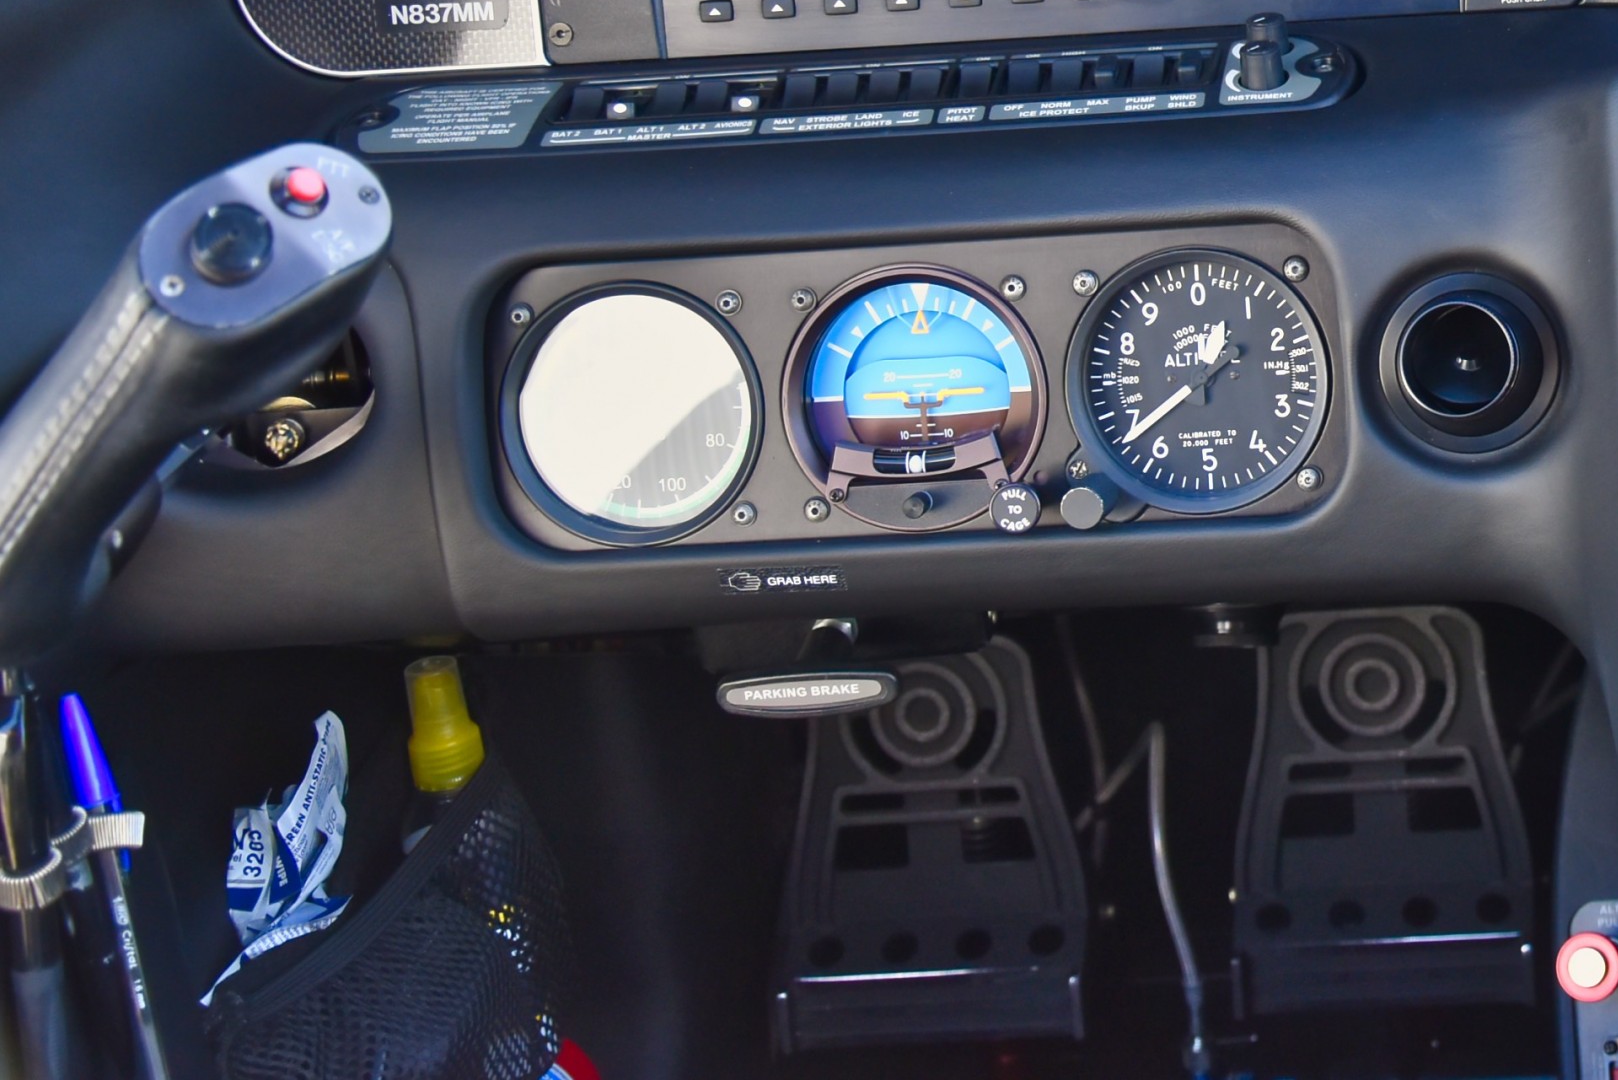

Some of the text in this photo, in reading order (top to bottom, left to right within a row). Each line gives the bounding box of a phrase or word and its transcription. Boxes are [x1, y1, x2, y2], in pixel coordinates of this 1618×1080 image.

[390, 1, 494, 25] N837MM
[1227, 91, 1294, 102] INSTRUMENT
[714, 120, 753, 129] AVIONICS
[798, 119, 892, 131] EXTERIOR LIGHTS
[627, 133, 672, 141] MASTER
[1211, 278, 1239, 291] FEET
[705, 433, 725, 448] 80
[658, 477, 687, 492] 100
[767, 574, 838, 586] GRAB HERE
[743, 683, 860, 701] PARKING BRAKE
[302, 746, 328, 811] ANTI-STATIC
[275, 855, 289, 888] WIPE
